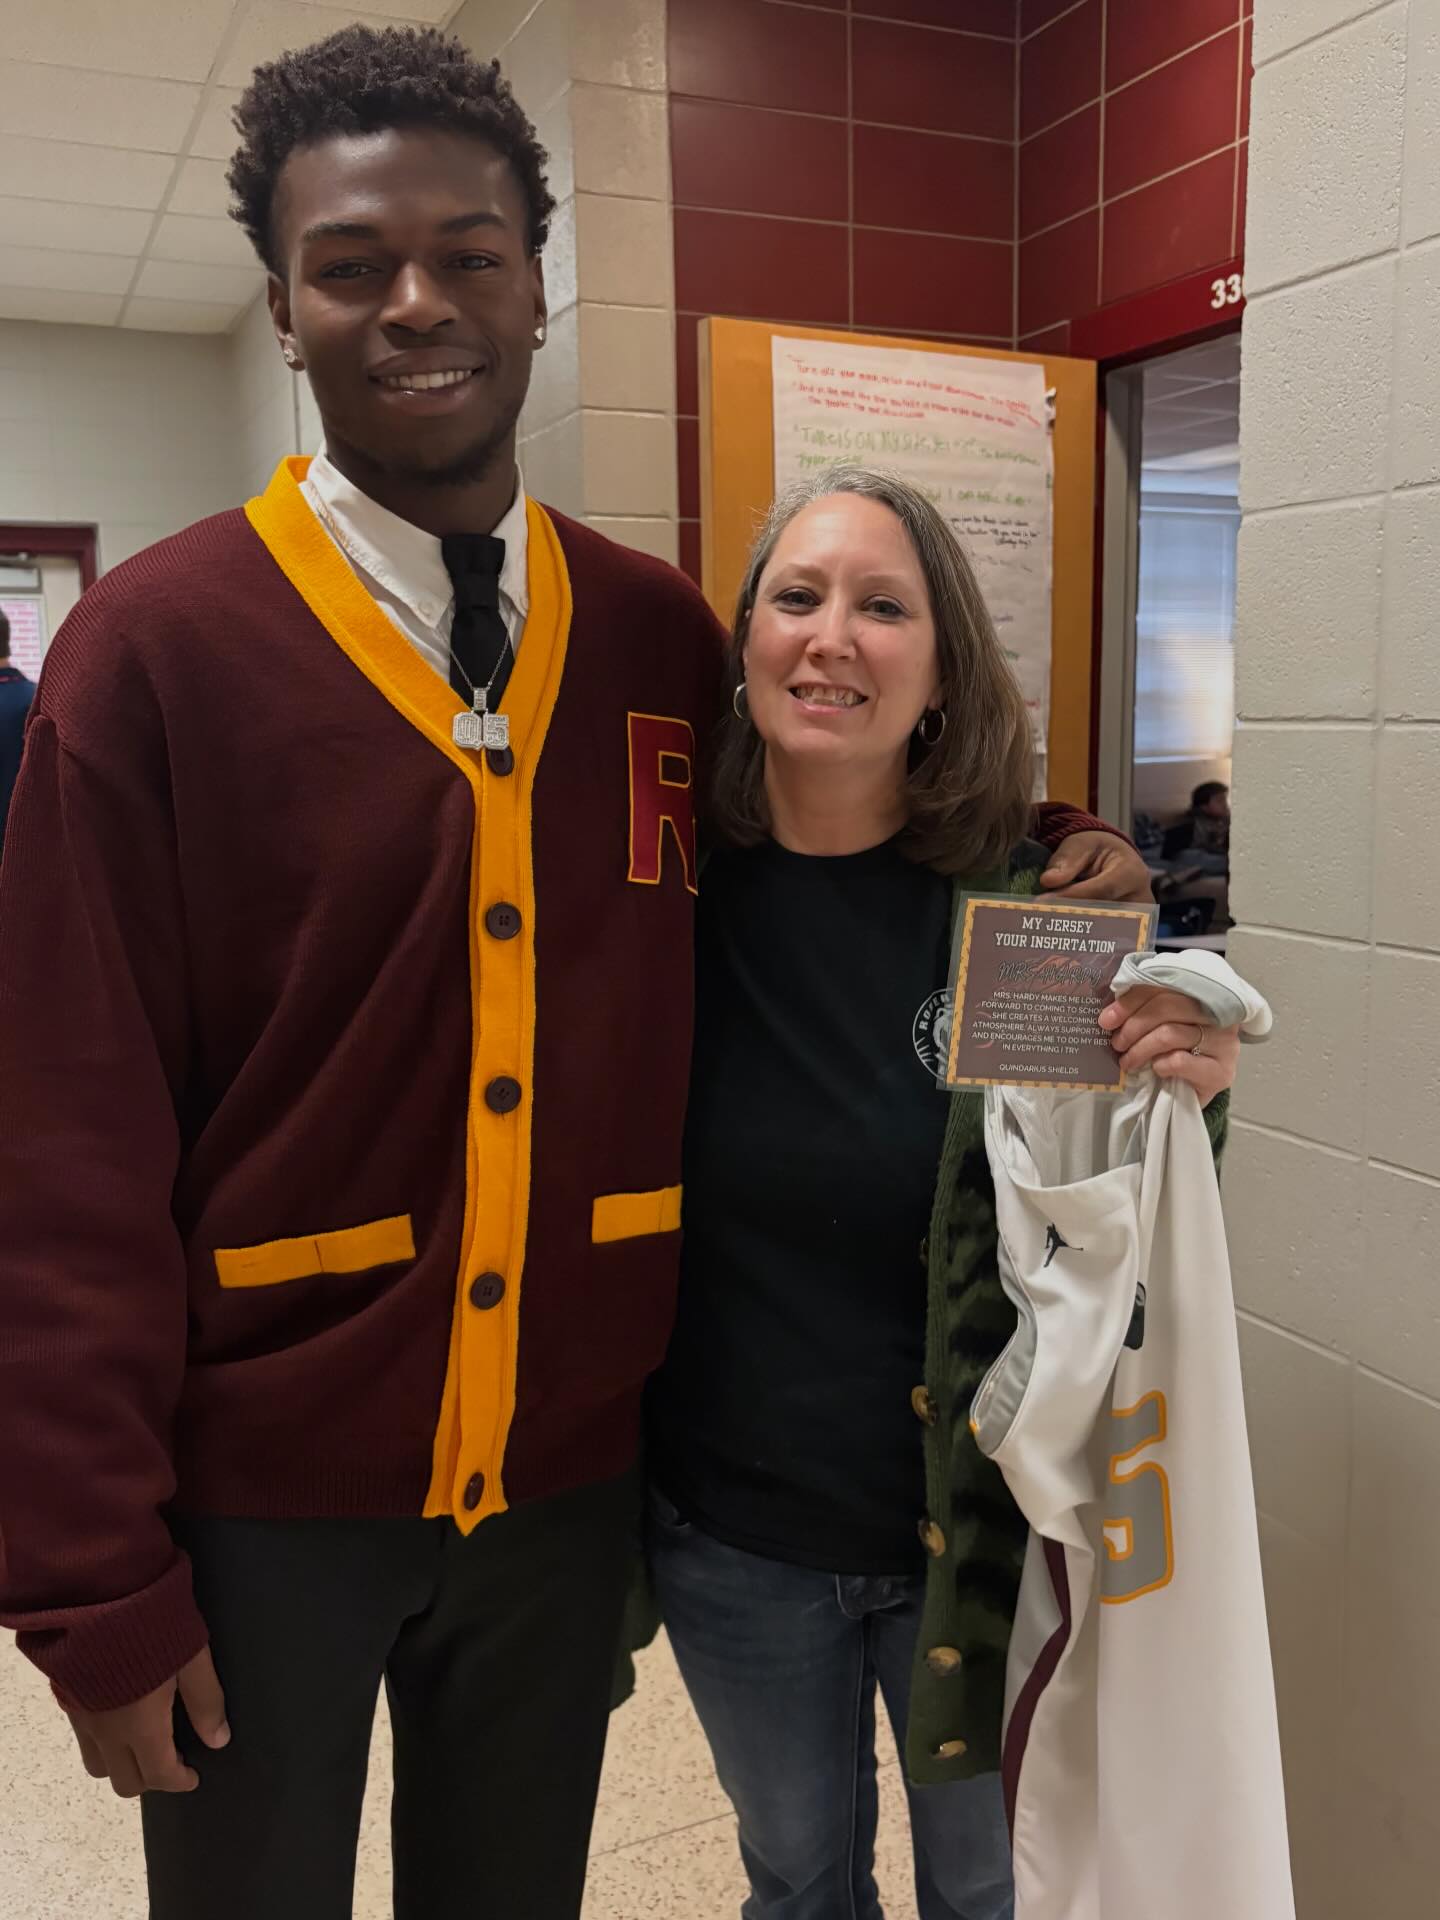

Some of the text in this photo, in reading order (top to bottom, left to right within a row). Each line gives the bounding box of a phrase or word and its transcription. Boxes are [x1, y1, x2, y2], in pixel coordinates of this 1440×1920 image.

[1210, 273, 1242, 309] 33
[627, 711, 699, 896] R
[1022, 916, 1094, 934] MY JERSEY
[995, 932, 1117, 953] YOUR INSPIRTATION
[1013, 992, 1040, 1001] HARDY
[1041, 994, 1067, 1003] MAKES
[981, 1000, 1021, 1010] FORWARD
[1022, 1003, 1033, 1011] TO
[1034, 1004, 1065, 1013] COMING
[1066, 1006, 1077, 1014] TO
[991, 1011, 1008, 1020] SHE
[1009, 1012, 1043, 1022] CREATES
[1027, 1024, 1060, 1033] ALWAYS
[1061, 1025, 1101, 1035] SUPPORTS
[971, 1031, 989, 1040] AND
[990, 1032, 1042, 1042] ENCOURAGES
[1043, 1035, 1055, 1043] ME
[1057, 1036, 1067, 1044] TO
[1068, 1036, 1080, 1045] DO
[1081, 1037, 1092, 1045] MY
[1002, 1042, 1011, 1051] IN
[1011, 1043, 1060, 1053] EVERYTHING
[1064, 1046, 1080, 1055] TRY
[999, 1063, 1080, 1075] QUINDARIUS SHIELDS
